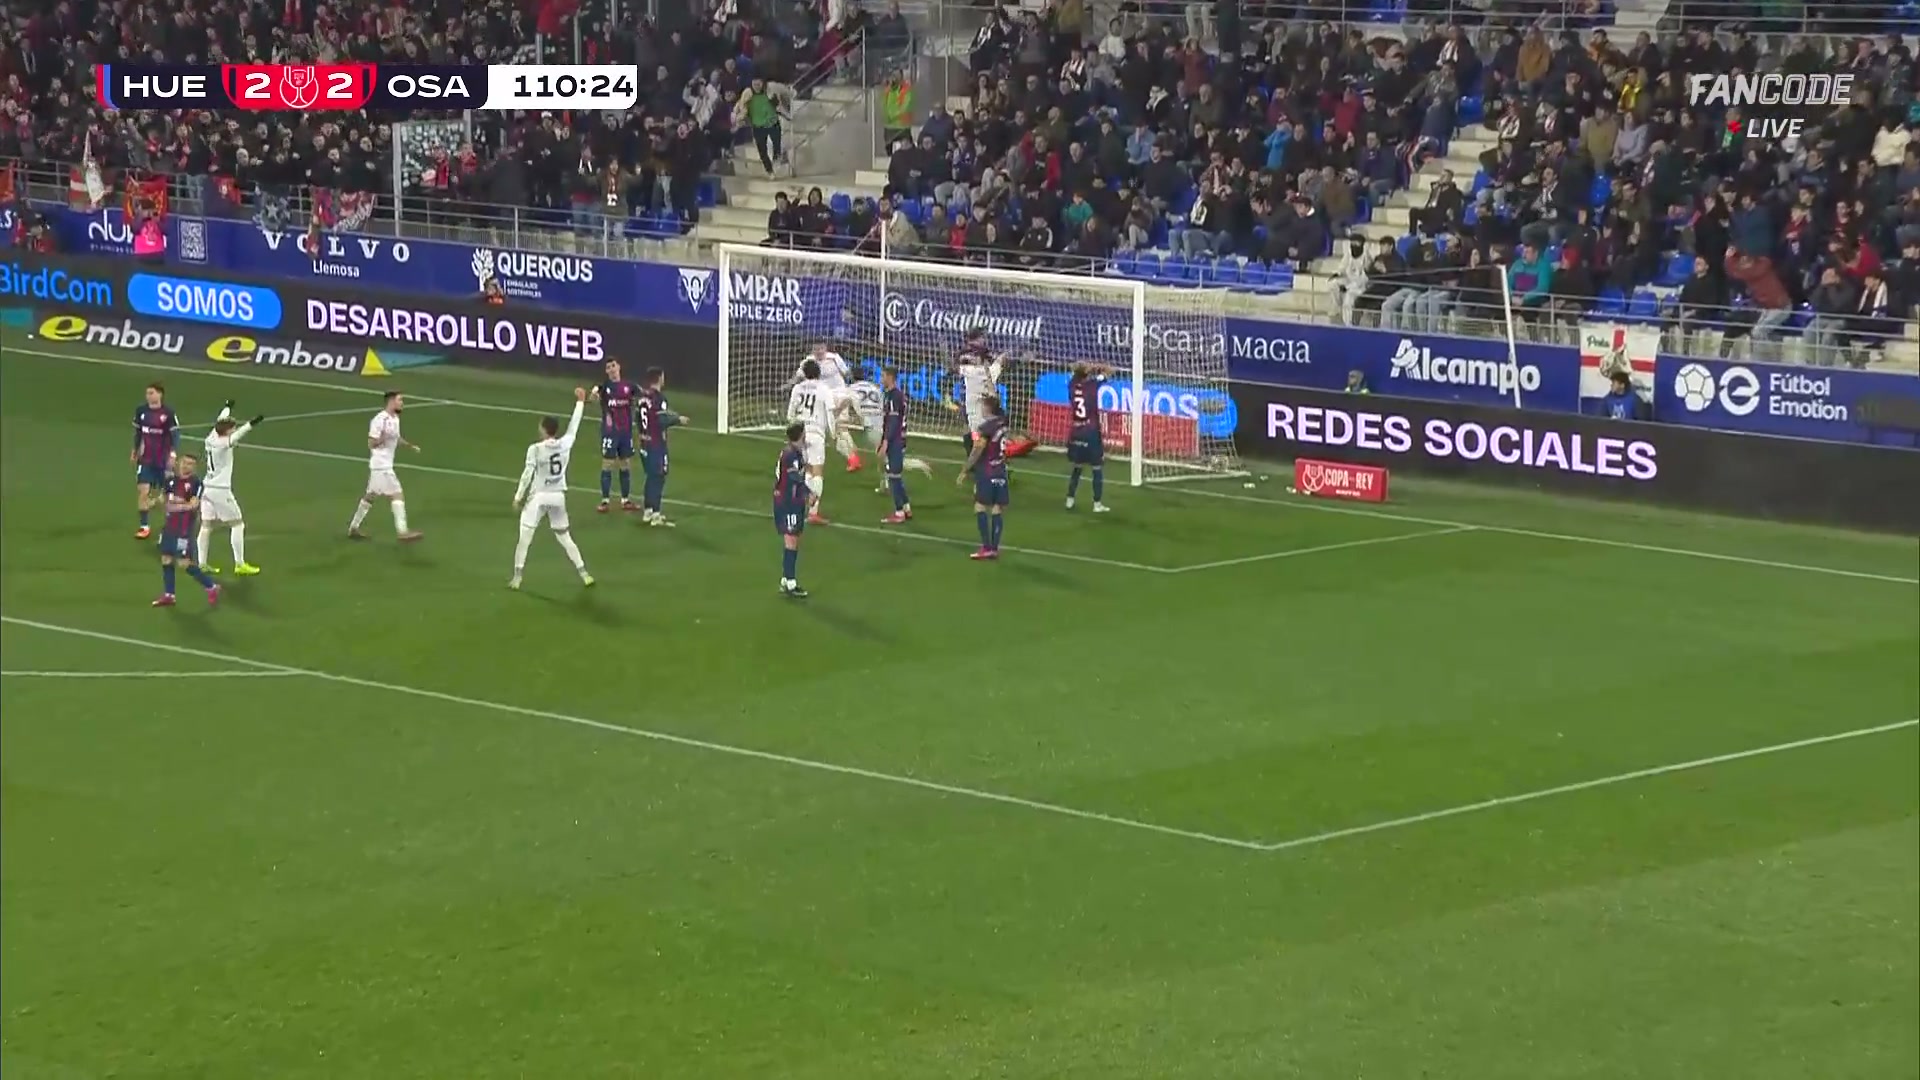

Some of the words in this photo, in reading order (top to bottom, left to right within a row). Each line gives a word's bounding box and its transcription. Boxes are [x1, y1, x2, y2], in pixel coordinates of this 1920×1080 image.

[262, 230, 411, 263] VOLVO
[0, 263, 112, 305] BirdCom
[312, 259, 361, 278] Llemosa
[497, 252, 593, 283] QUERQUS
[157, 281, 254, 321] SOMOS
[721, 303, 762, 321] RIPLE
[766, 306, 803, 324] ZERO
[914, 298, 1043, 338] Casademont
[39, 315, 184, 354] embou
[307, 299, 517, 352] DESARROLLO
[525, 322, 605, 362] WEB
[206, 335, 358, 373] embou
[1389, 338, 1542, 395] Alcampo
[1769, 373, 1830, 396] Fútbol
[1074, 397, 1087, 419] 3
[1097, 384, 1199, 420] OMOS
[1769, 396, 1848, 421] Emotion
[1266, 402, 1412, 453] REDES
[1424, 419, 1658, 480] SOCIALES
[549, 453, 562, 476] 6
[1324, 468, 1349, 488] COPA
[1356, 472, 1374, 491] REY
